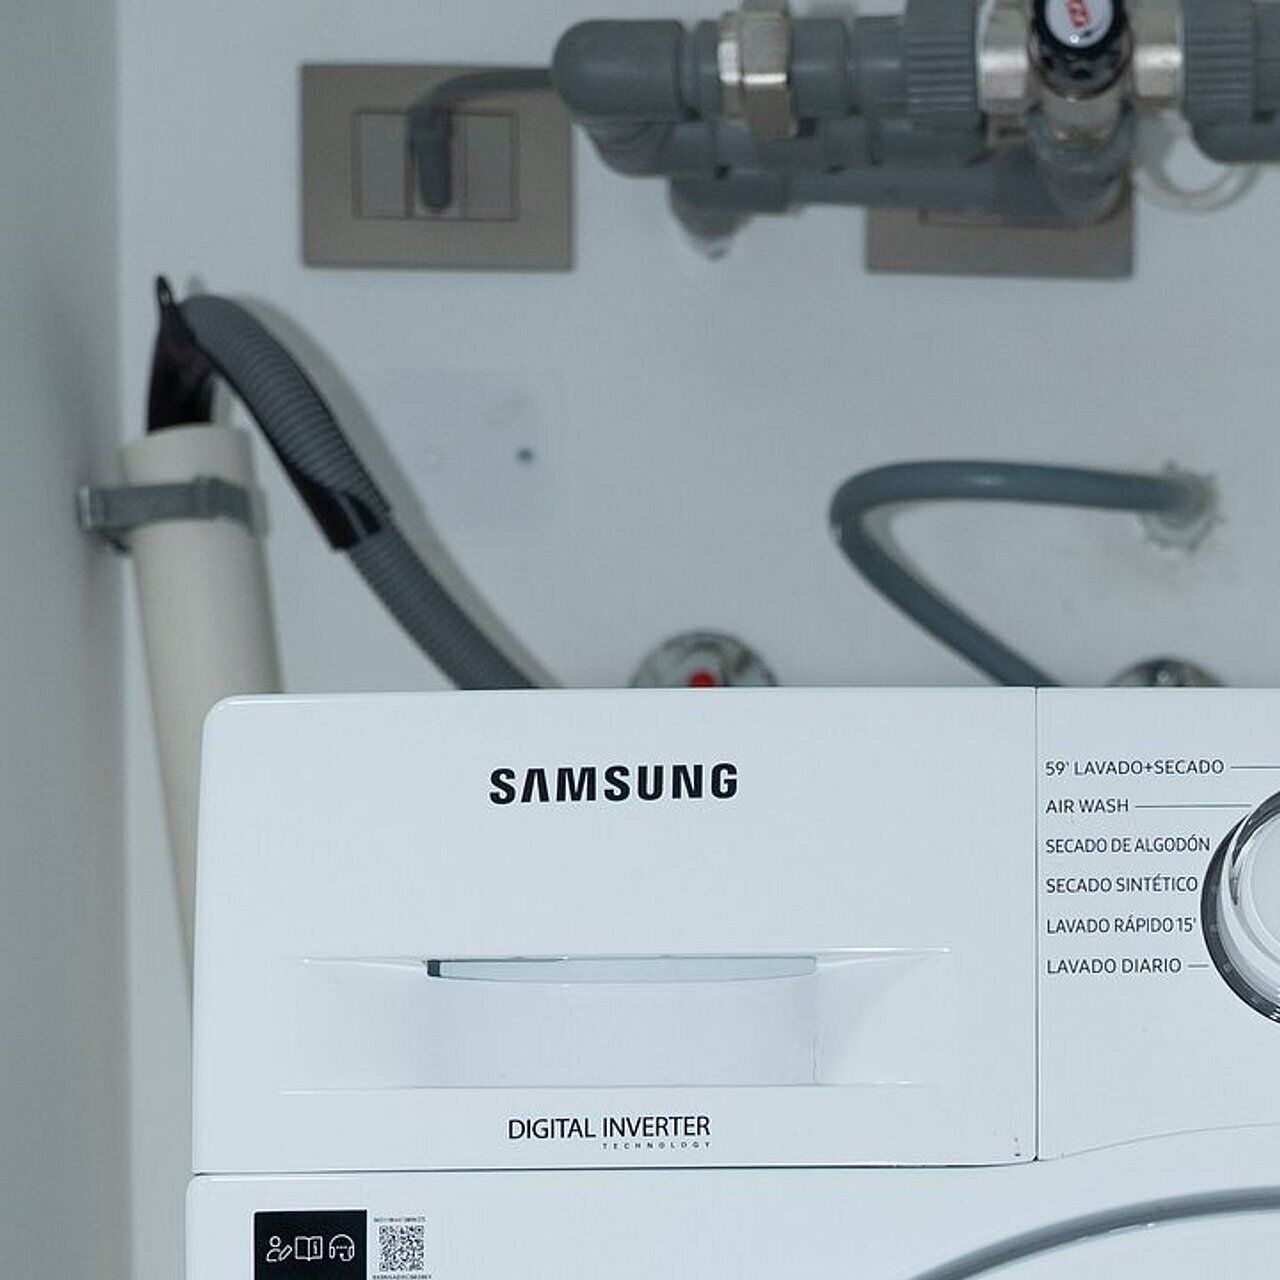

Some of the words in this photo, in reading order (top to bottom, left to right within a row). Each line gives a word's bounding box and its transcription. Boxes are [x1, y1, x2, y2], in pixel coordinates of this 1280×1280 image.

[1074, 759, 1225, 776] LAVADO+SECADO
[489, 762, 739, 805] SAMSUNG
[1045, 799, 1075, 814] AIR
[1079, 798, 1129, 814] WASH
[1045, 838, 1107, 854] SECADO
[1111, 838, 1132, 853] DE
[1134, 834, 1211, 852] ALGODÓN
[1046, 877, 1113, 894] SECADO
[1116, 873, 1199, 892] SINTÉTICO
[1046, 918, 1111, 935] LAVADO
[1114, 914, 1175, 933] RÁPIDO
[1047, 958, 1118, 975] LAVADO
[1121, 957, 1183, 974] DIARIO
[507, 1118, 597, 1139] DIGITAL
[602, 1116, 711, 1138] INVERTER
[602, 1141, 711, 1150] TECHNOLOGY
